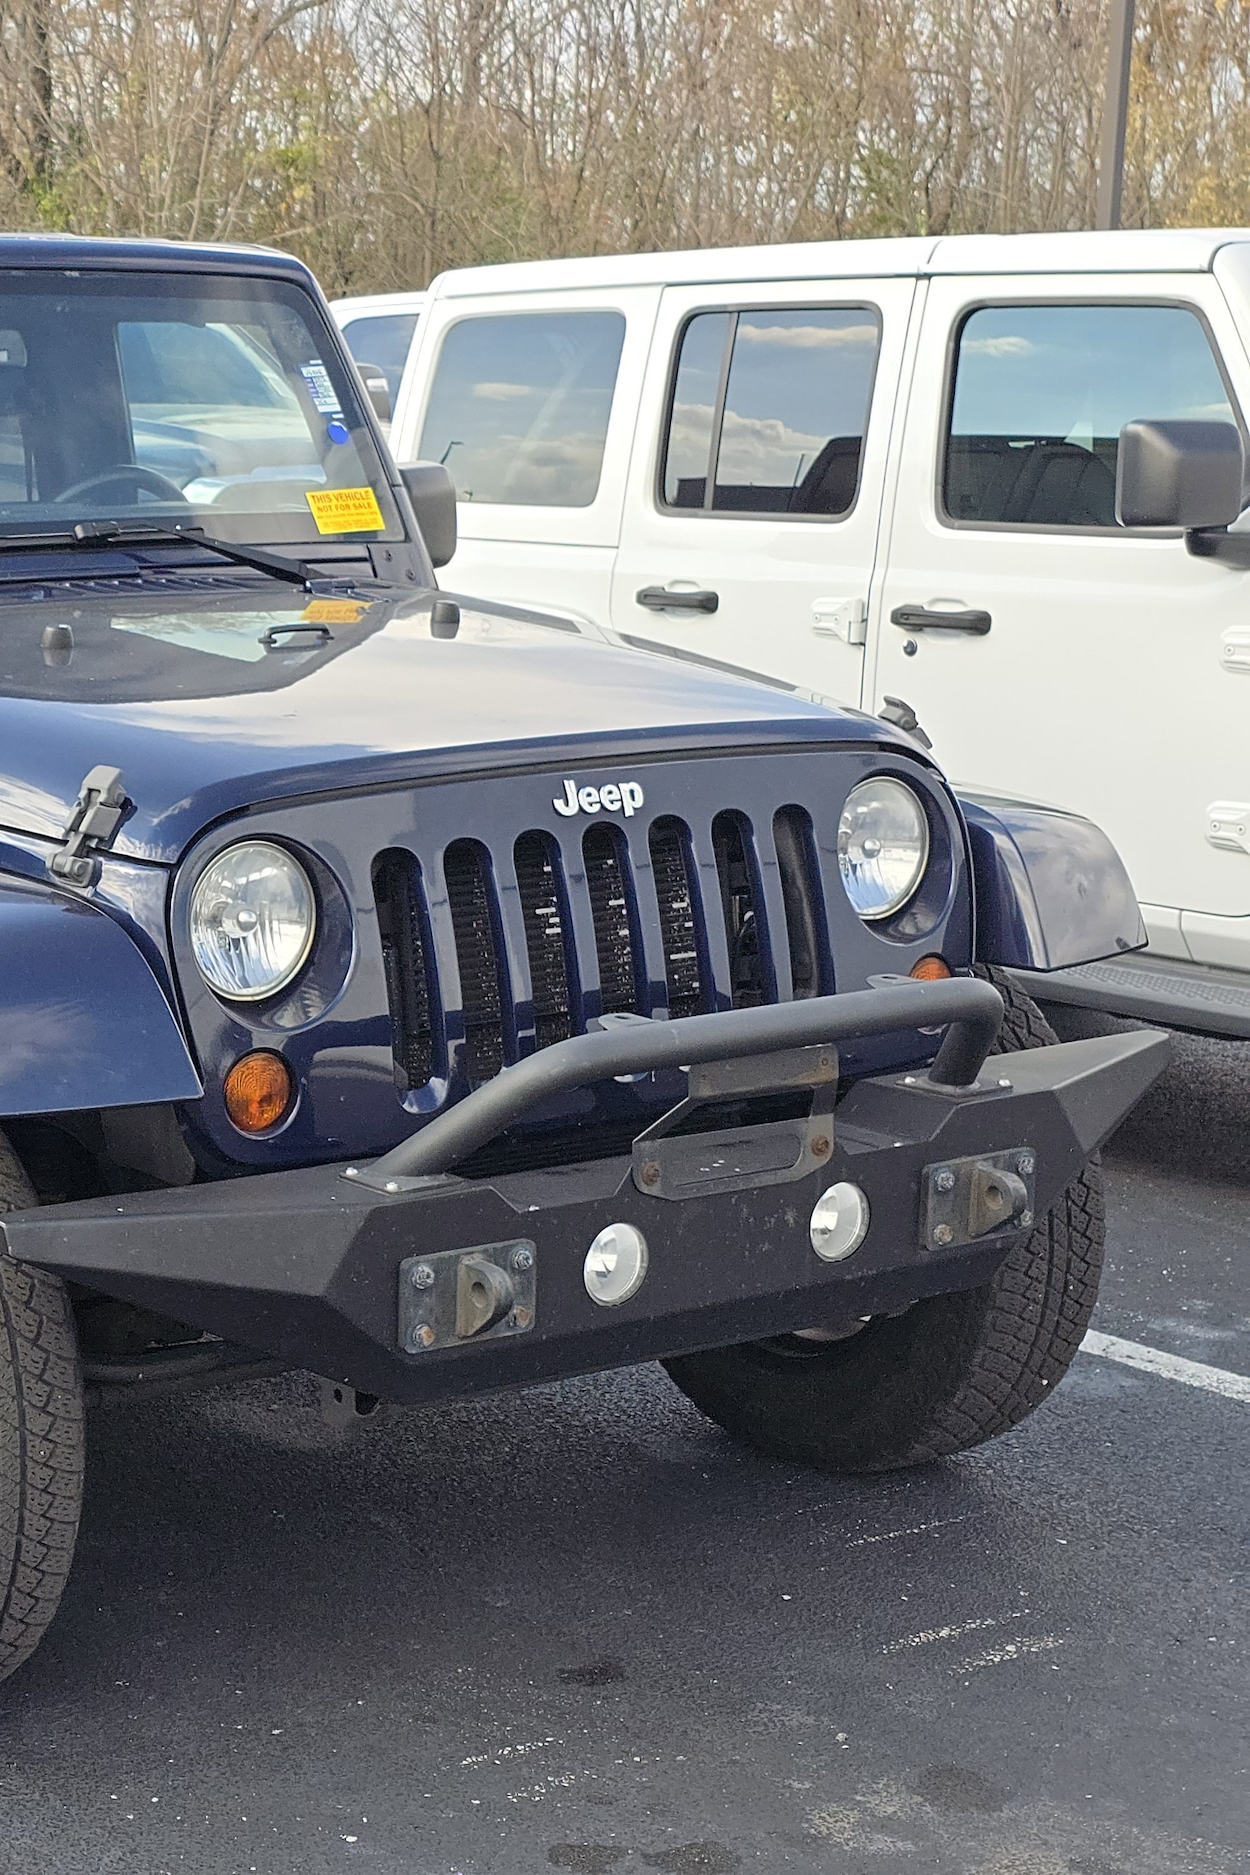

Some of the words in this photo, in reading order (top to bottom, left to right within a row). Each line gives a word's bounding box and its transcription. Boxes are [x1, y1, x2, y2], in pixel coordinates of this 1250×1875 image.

[311, 493, 332, 504] THIS
[333, 490, 372, 502] VEHICLE
[317, 505, 333, 513] NOT
[335, 503, 351, 511] FOR
[353, 502, 373, 510] SALE
[552, 779, 644, 818] Jeep
